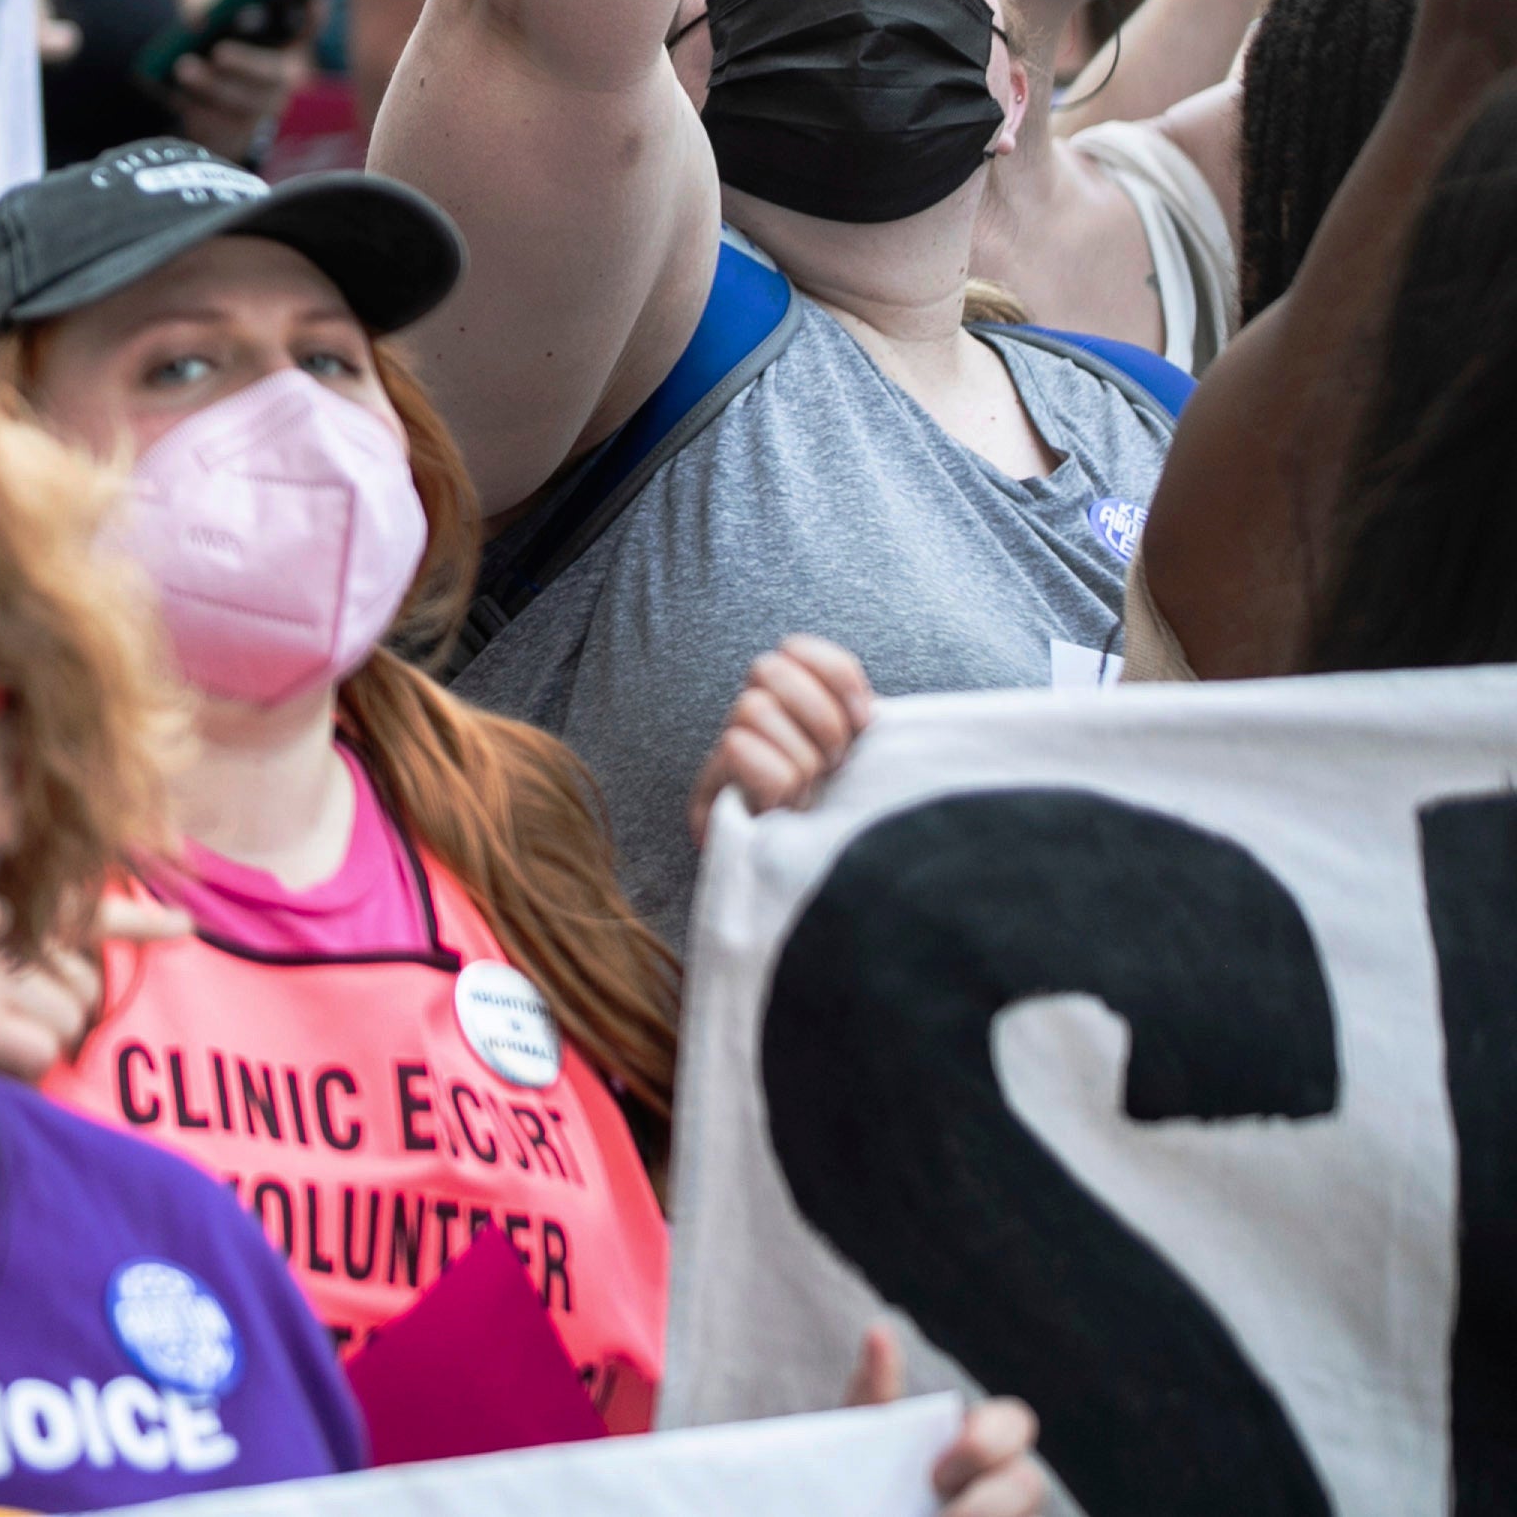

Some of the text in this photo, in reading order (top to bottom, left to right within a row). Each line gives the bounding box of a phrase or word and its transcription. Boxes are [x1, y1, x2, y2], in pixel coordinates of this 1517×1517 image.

[117, 1042, 583, 1185] CLINIC ECRT
[758, 785, 1517, 1517] S
[227, 1176, 572, 1313] OLUNTER
